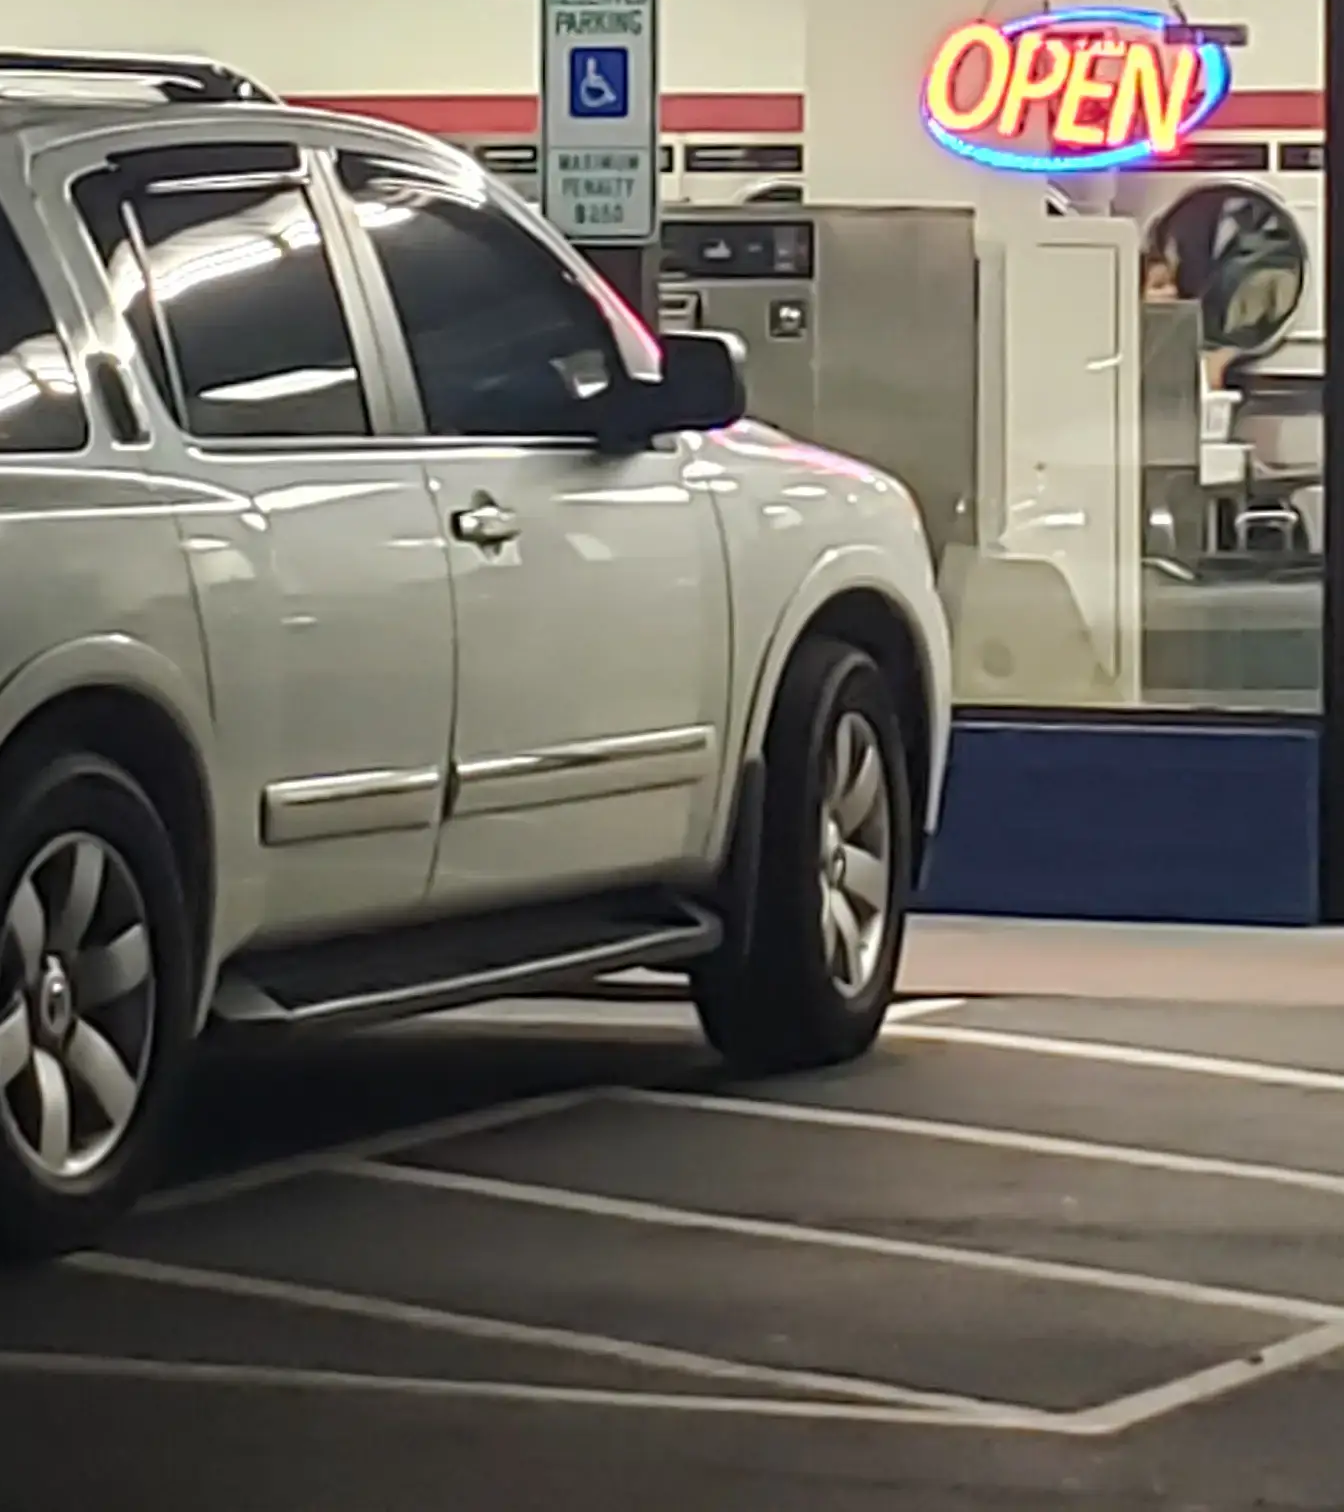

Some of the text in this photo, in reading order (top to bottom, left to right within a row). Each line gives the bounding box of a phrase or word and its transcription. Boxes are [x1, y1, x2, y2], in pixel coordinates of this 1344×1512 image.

[555, 8, 643, 36] PARKING
[925, 22, 1198, 155] OPEN
[558, 153, 640, 171] MAXIMUM
[561, 177, 636, 199] PENALTY
